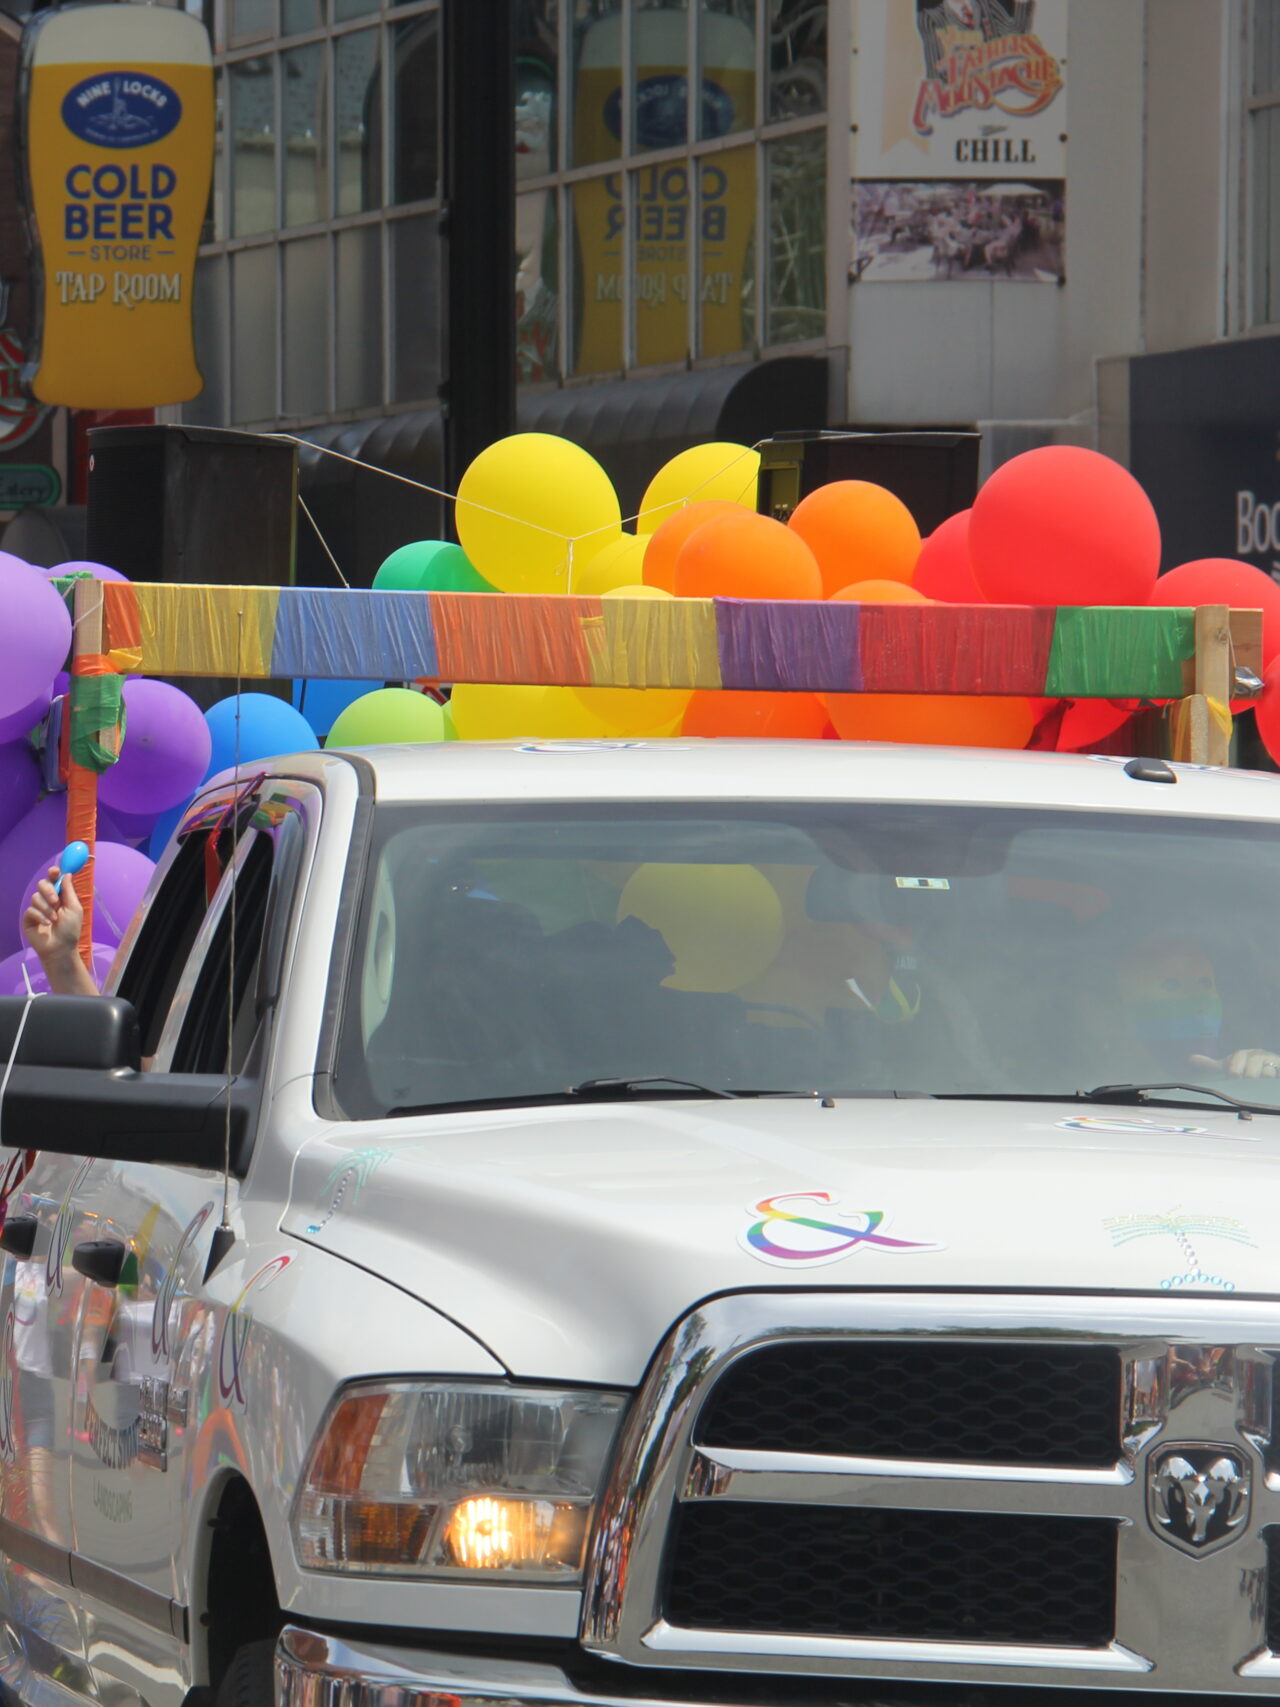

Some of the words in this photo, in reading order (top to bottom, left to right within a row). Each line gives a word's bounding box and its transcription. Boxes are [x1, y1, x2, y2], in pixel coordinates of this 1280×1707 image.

[76, 81, 111, 107] NINE
[123, 80, 168, 108] LOCKS
[955, 138, 1036, 163] CHILL
[65, 163, 177, 200] COLD
[64, 203, 176, 240] BEER
[90, 245, 152, 261] STORE
[56, 271, 106, 306] TAP
[112, 271, 182, 310] ROOM
